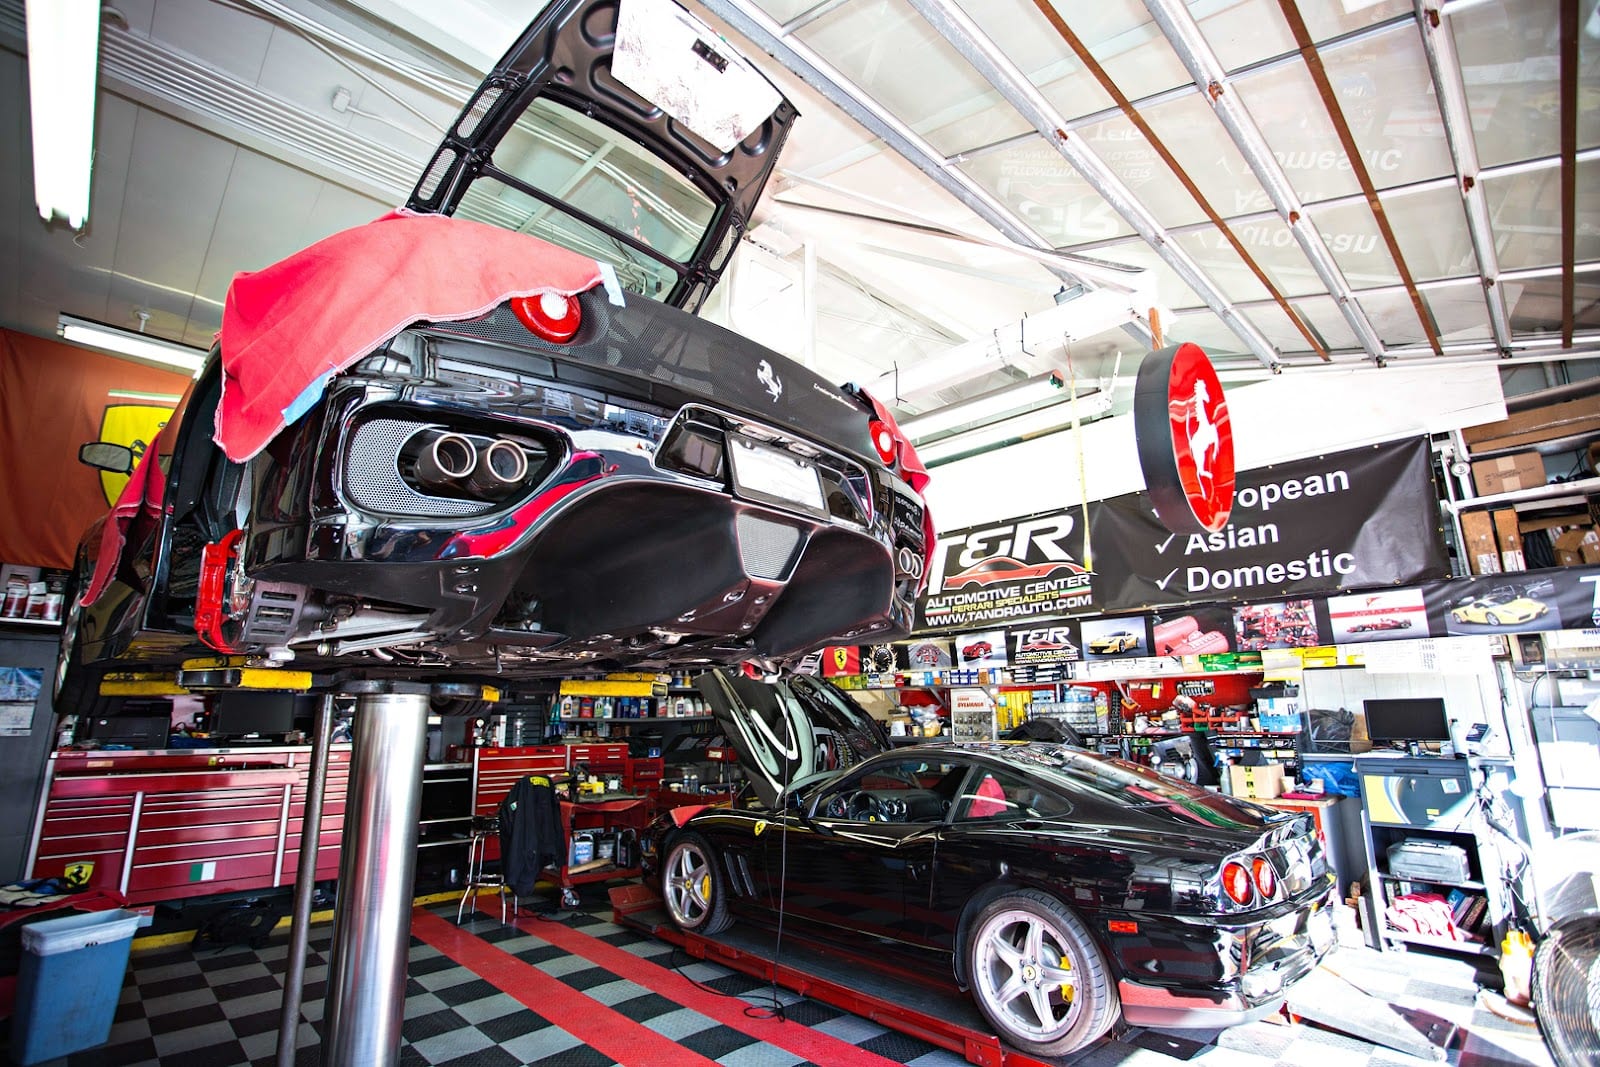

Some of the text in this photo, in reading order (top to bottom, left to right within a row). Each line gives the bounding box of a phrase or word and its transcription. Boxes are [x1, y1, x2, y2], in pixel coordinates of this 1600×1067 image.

[1233, 469, 1351, 512] opean
[1184, 523, 1280, 556] Asian
[1186, 549, 1357, 593] Domestic
[925, 573, 1091, 610] AUTOMOTIVE CENTER
[951, 590, 1060, 613] FERRARI SPECIALISTS
[925, 594, 1093, 627] WWW.TANDRAUTO.COM
